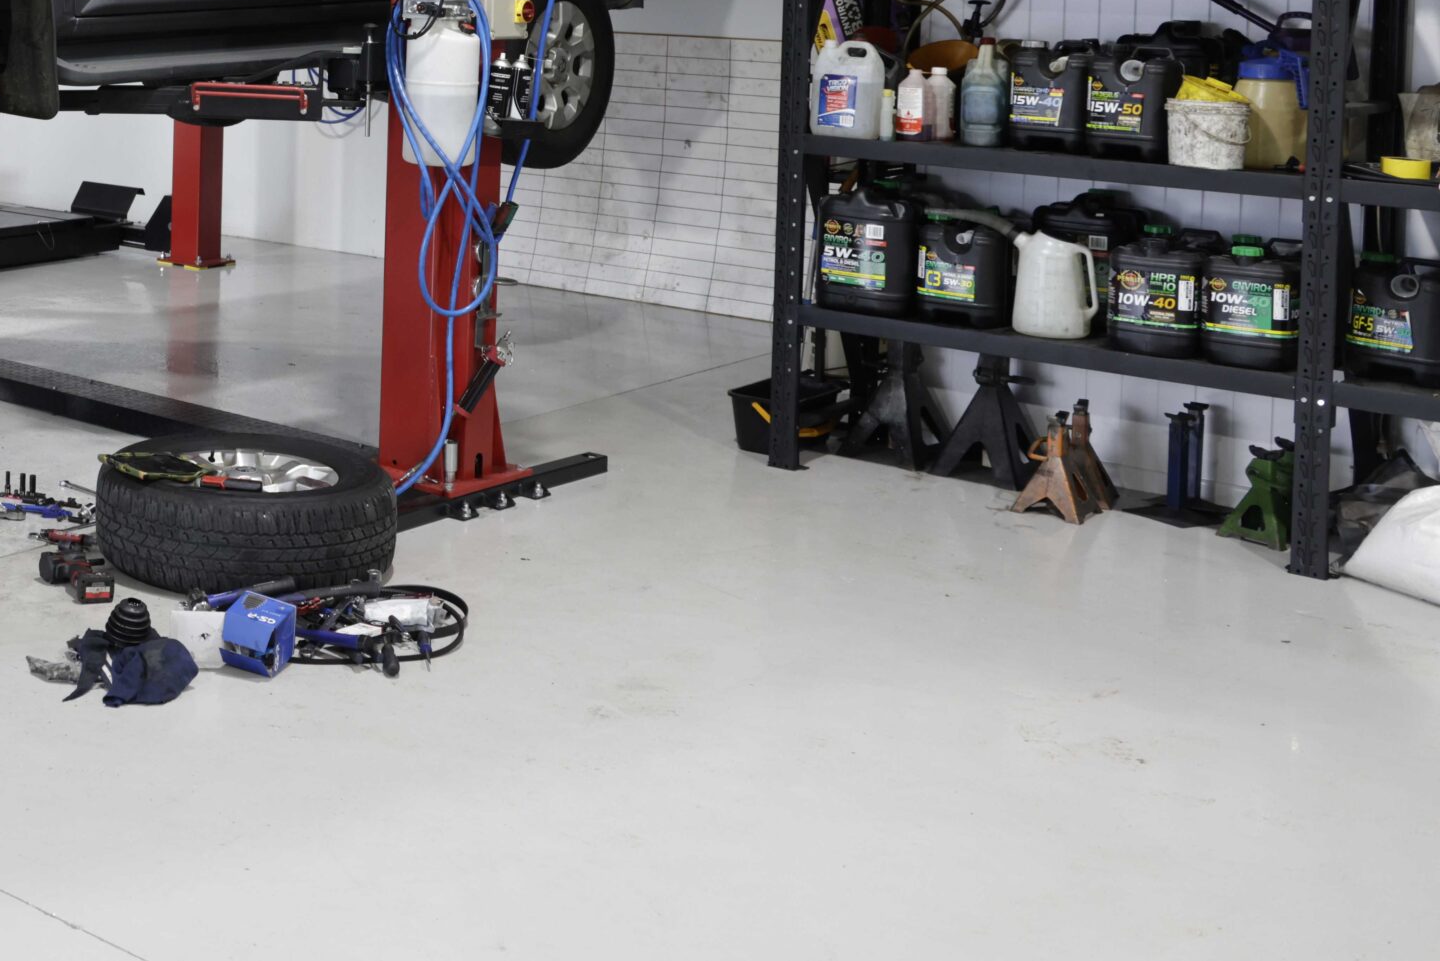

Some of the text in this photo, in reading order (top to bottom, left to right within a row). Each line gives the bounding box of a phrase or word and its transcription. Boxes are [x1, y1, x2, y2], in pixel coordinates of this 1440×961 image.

[1013, 95, 1061, 107] 15W-40
[1090, 101, 1142, 115] 15W-50
[824, 245, 885, 263] 5W-40
[926, 270, 941, 287] C3
[1150, 272, 1176, 282] HPR
[1232, 281, 1272, 292] ENVIRO+
[1118, 292, 1176, 310] 10W-40
[1211, 292, 1271, 307] 10W-40
[1222, 305, 1257, 316] DIESEL
[1353, 315, 1374, 331] GF-5
